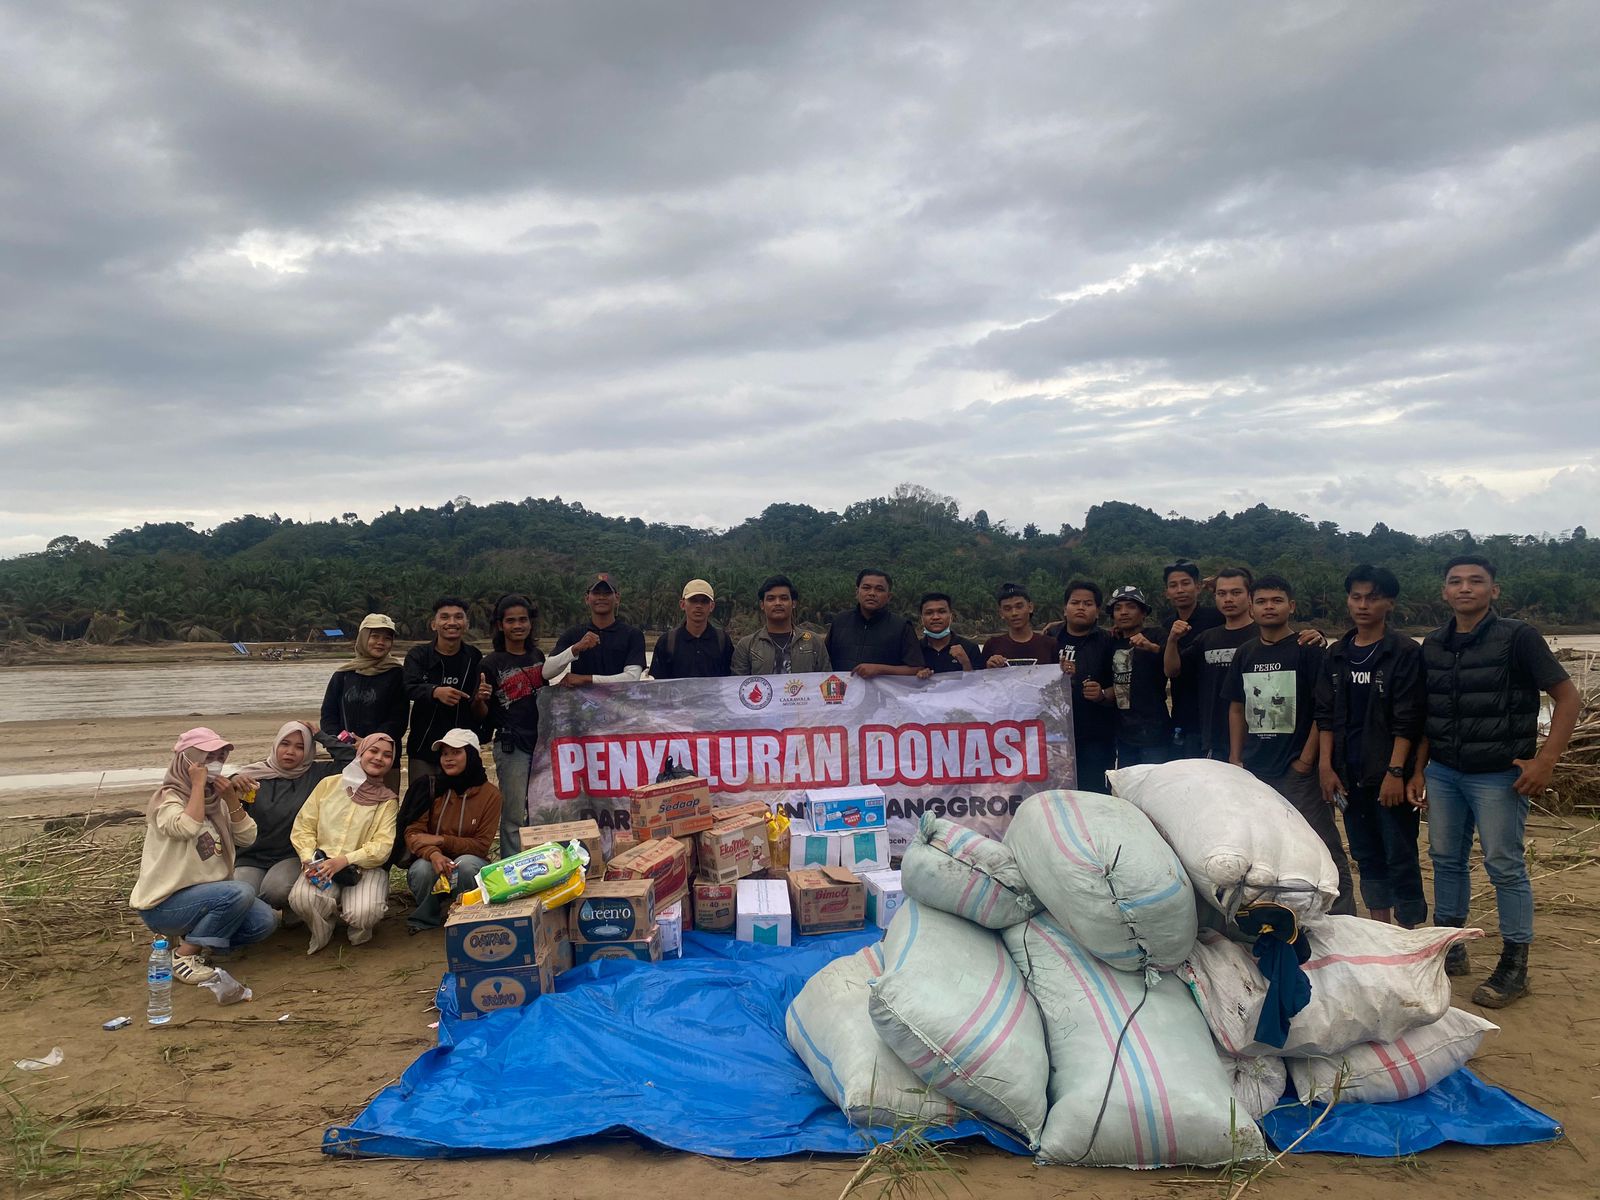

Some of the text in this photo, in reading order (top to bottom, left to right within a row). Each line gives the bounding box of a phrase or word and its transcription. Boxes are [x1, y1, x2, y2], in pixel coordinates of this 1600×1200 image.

[557, 726, 1041, 793] PENYALURAN DONASI
[580, 809, 631, 830] DAR
[886, 795, 1023, 819] ANGGRO
[659, 799, 700, 813] Sedaap
[815, 887, 850, 900] Bimoli
